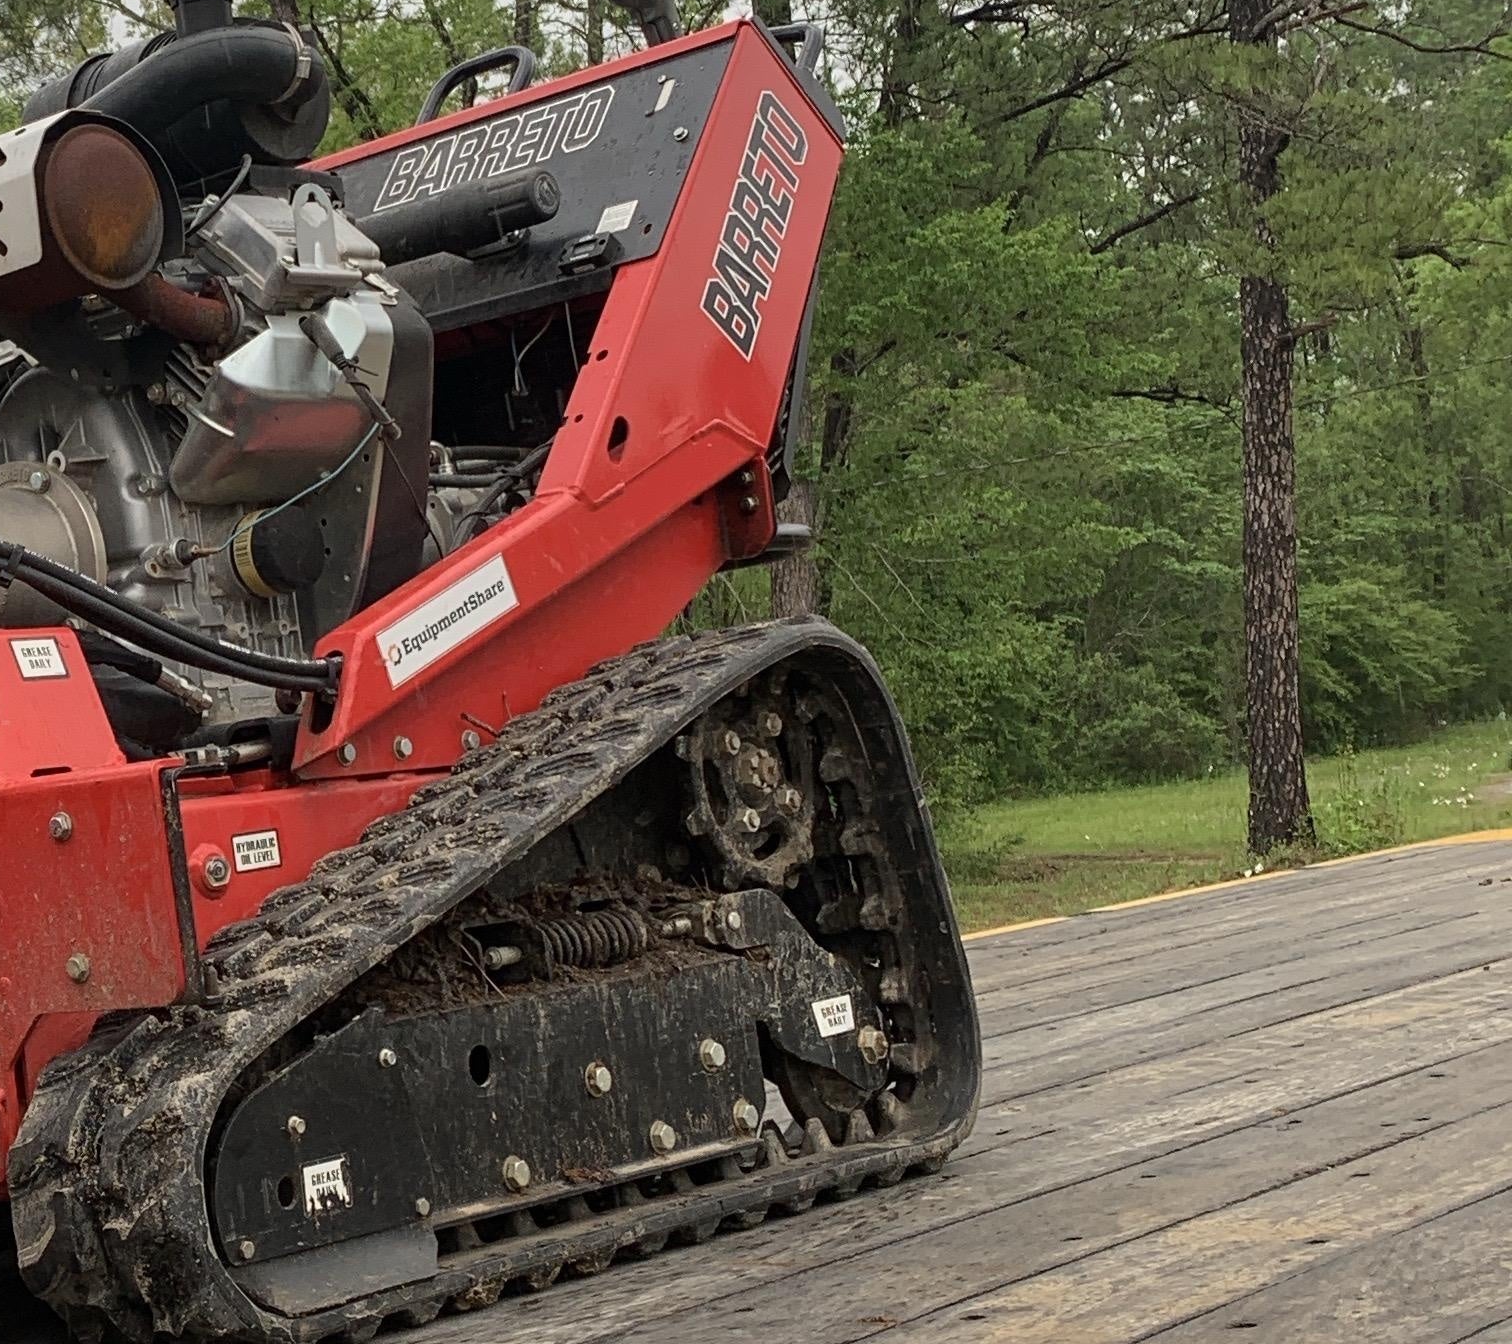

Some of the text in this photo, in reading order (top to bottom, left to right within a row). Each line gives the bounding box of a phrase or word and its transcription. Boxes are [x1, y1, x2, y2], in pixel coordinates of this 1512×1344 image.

[373, 85, 615, 212] BARRETO
[699, 90, 808, 362] BARRETO
[401, 580, 505, 655] EquipmentShare
[21, 646, 53, 658] GREASE
[29, 657, 52, 670] DAILY
[236, 837, 276, 854] HYDRAULIC
[241, 850, 275, 866] OIL LEVEL
[311, 1168, 340, 1186] GREASE
